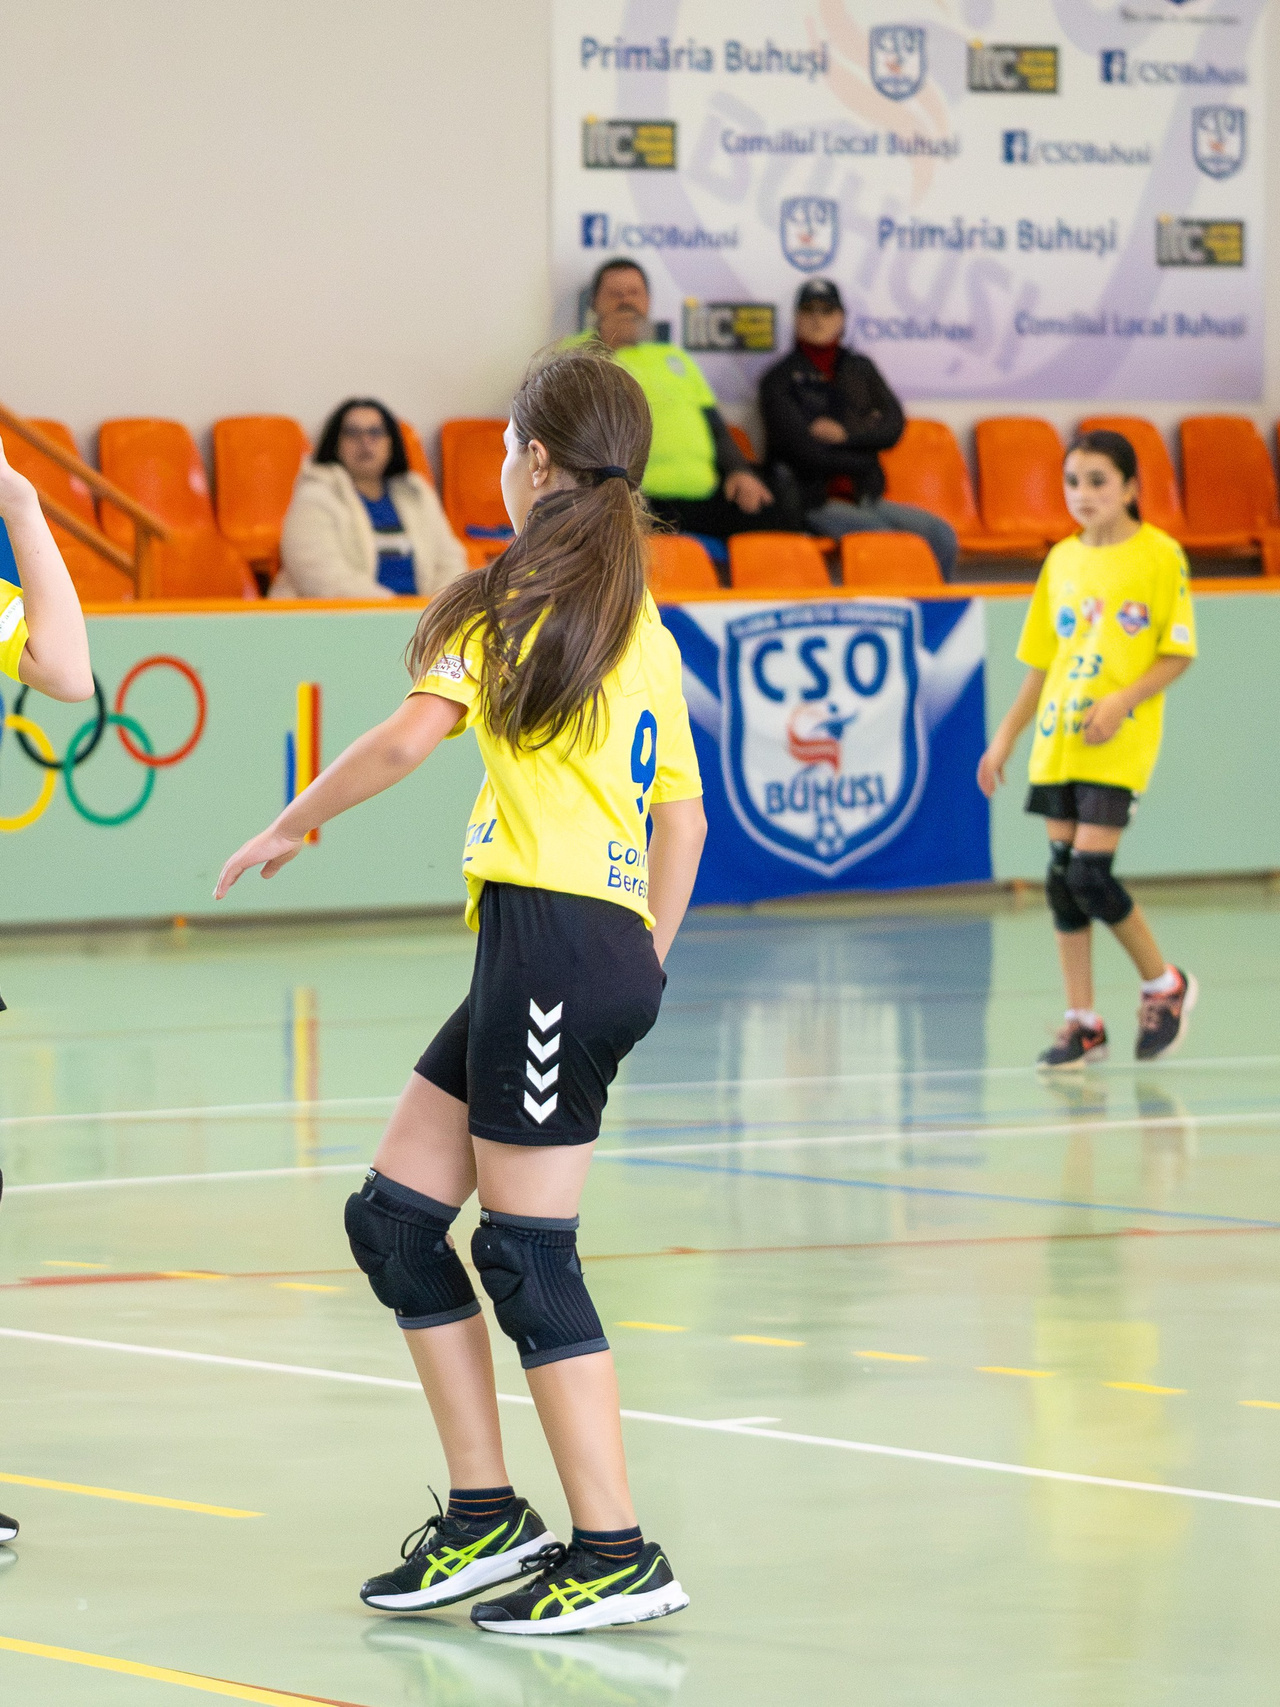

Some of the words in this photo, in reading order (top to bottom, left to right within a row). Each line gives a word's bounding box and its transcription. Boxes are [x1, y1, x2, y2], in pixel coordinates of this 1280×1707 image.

[581, 36, 714, 72] Primăria
[877, 215, 1006, 251] Primăria
[751, 633, 889, 703] CSO
[1069, 654, 1104, 680] 23
